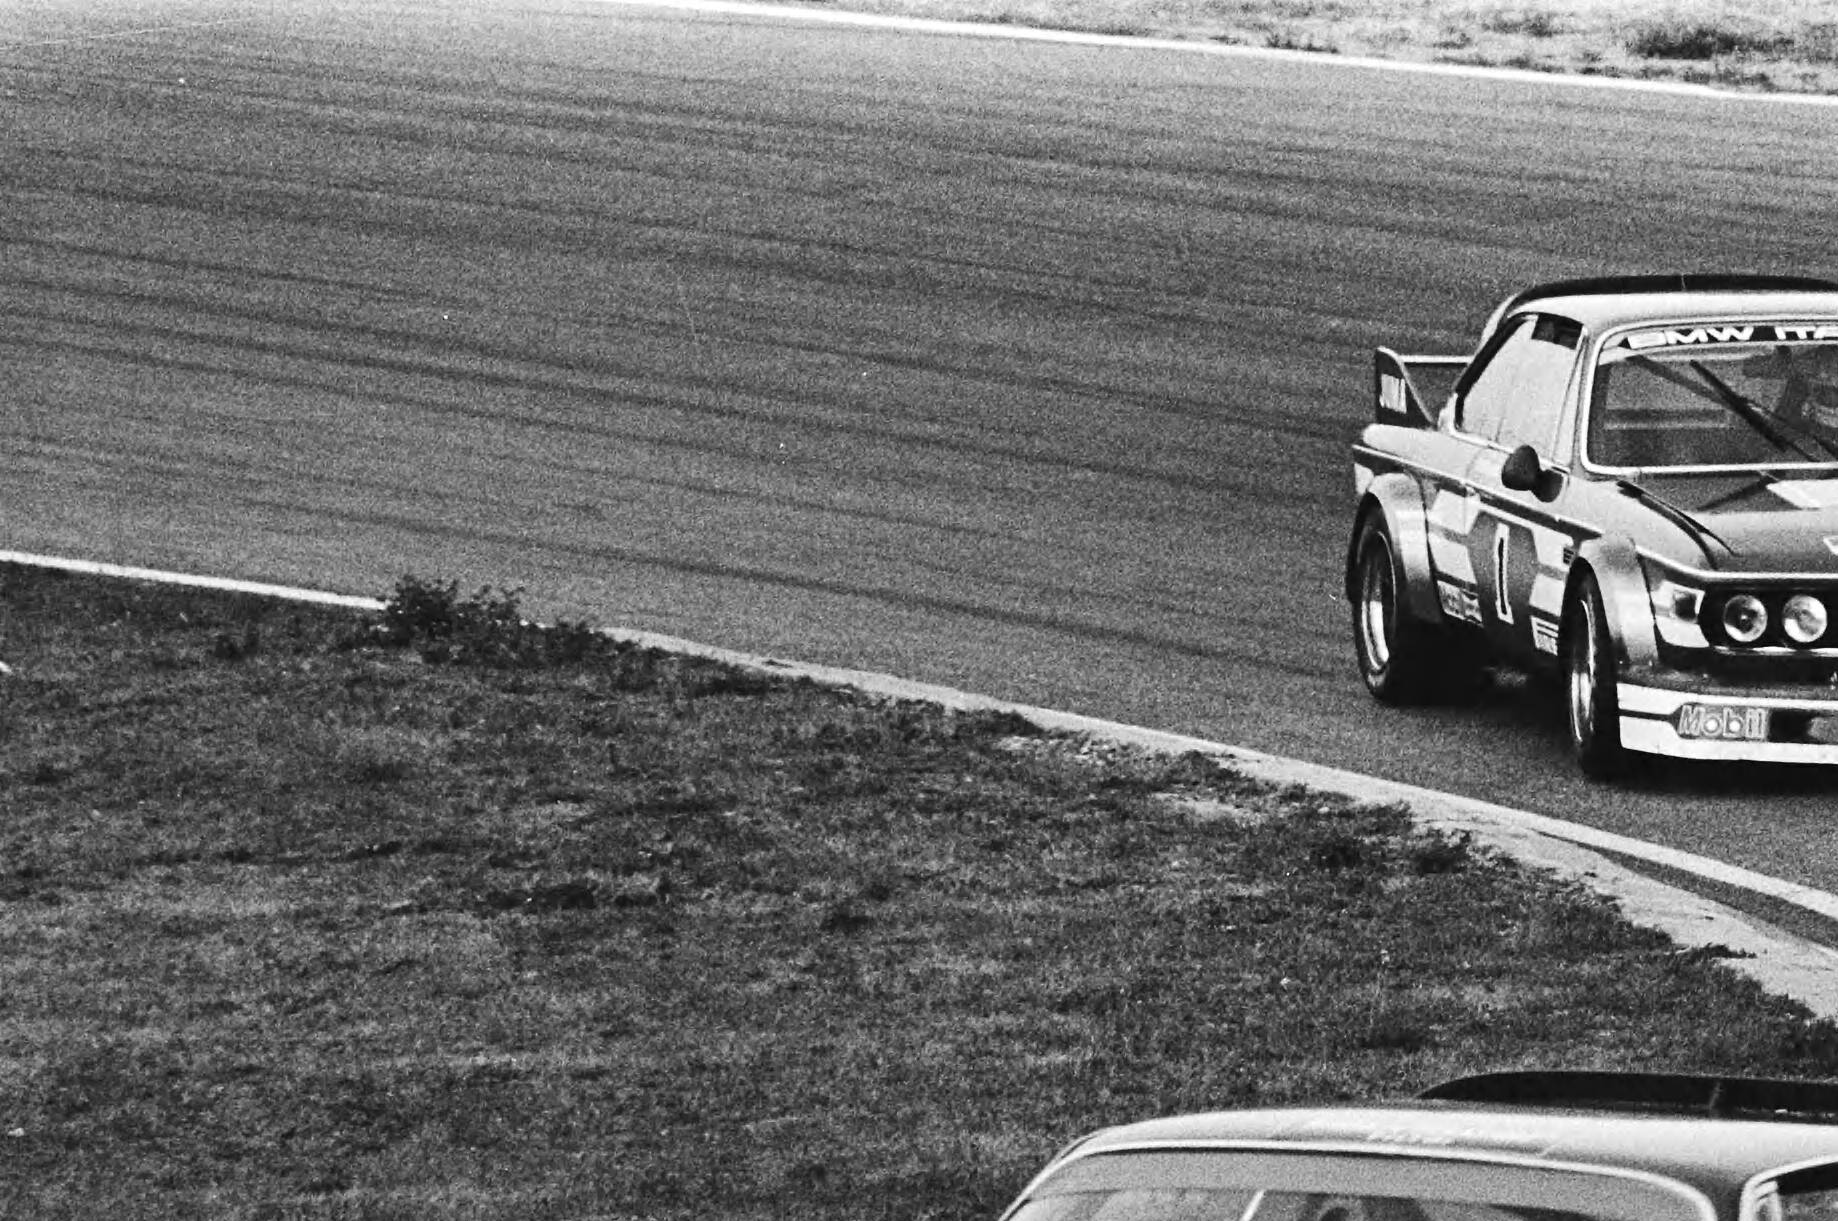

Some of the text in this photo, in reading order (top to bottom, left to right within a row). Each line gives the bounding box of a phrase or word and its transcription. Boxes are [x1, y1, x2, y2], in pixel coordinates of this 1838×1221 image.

[1627, 326, 1753, 349] BMW
[1495, 523, 1514, 625] 1
[1678, 704, 1768, 739] Mobil
